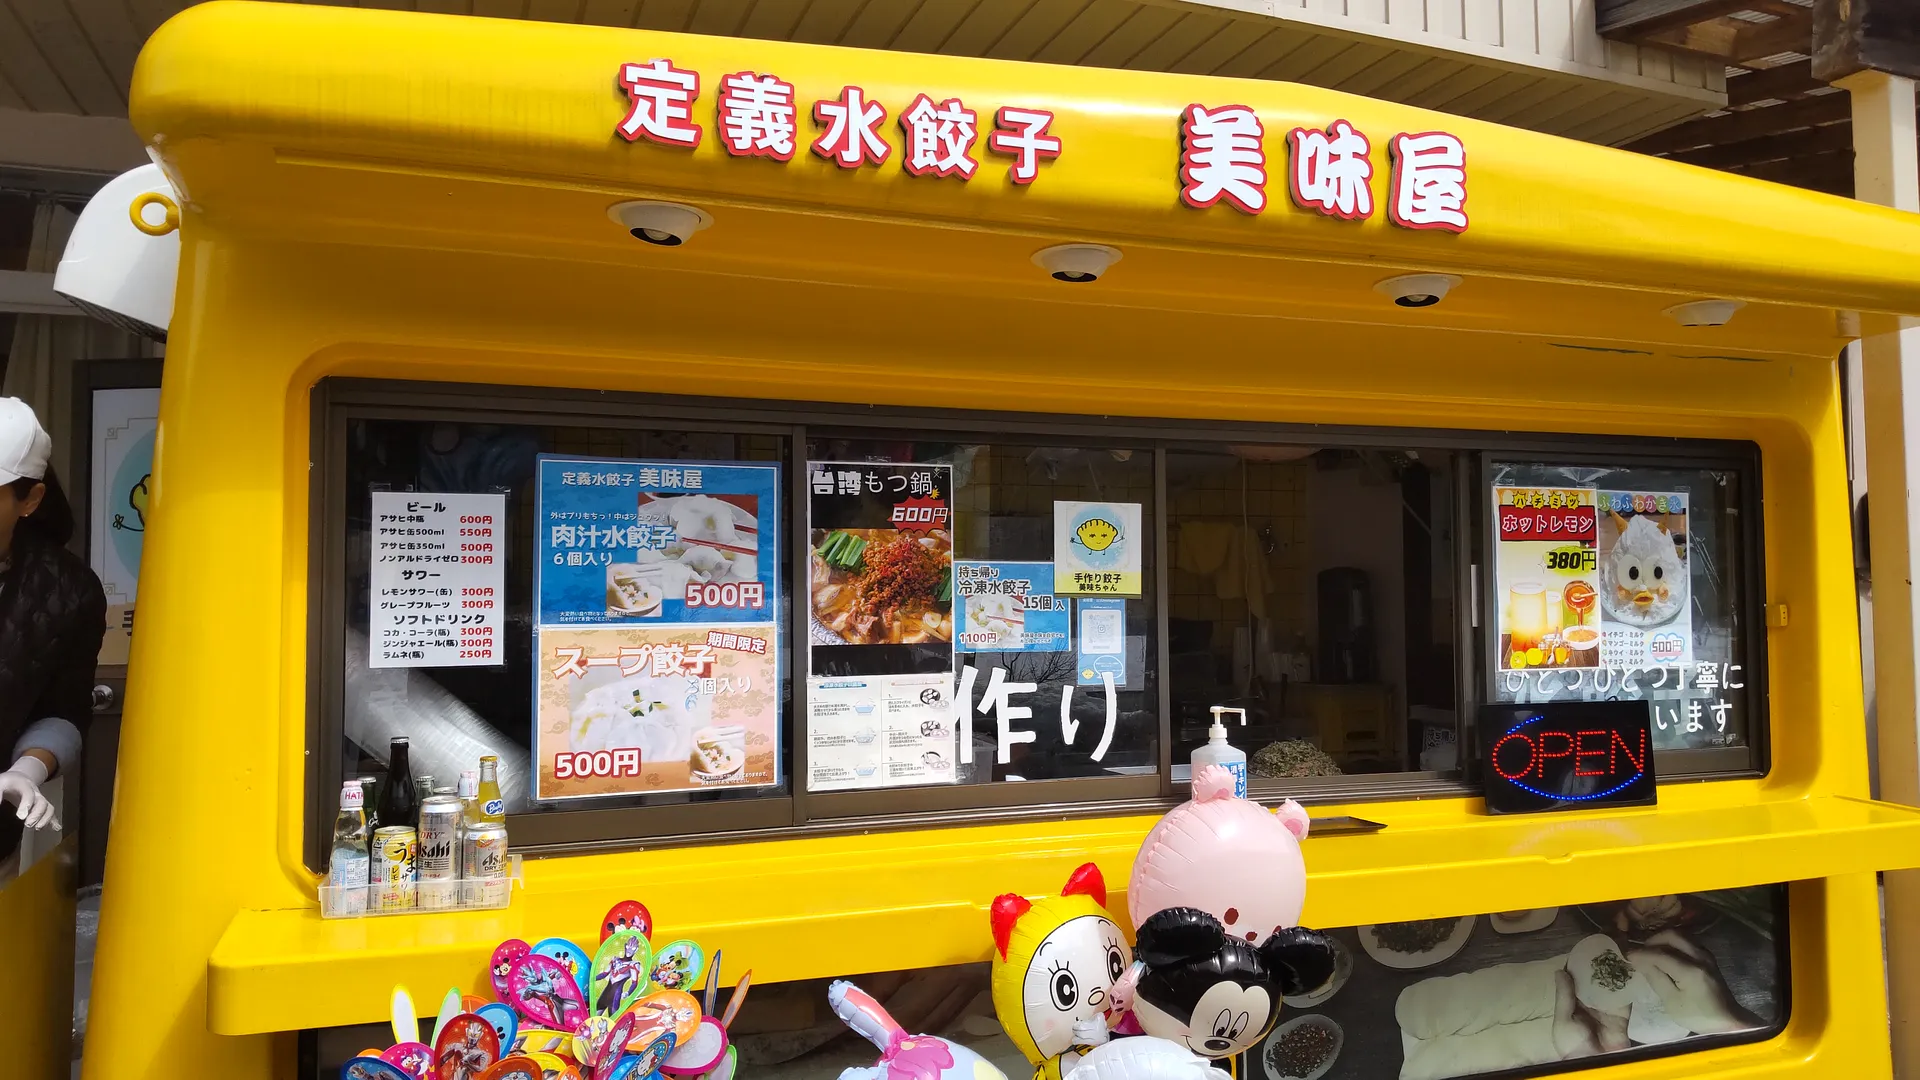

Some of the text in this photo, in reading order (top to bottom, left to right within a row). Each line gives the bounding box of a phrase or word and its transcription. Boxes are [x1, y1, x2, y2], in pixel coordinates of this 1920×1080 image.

[618, 59, 1469, 233] 定義水餃子 美味屋
[562, 467, 703, 489] 定義水餃子 美味屋
[812, 471, 933, 496] 台湾もつ鍋
[407, 502, 446, 513] ビール
[1514, 493, 1579, 508] ハチミツ
[1599, 495, 1680, 511] ふわふわかき氷
[380, 515, 492, 524] アサヒ中瓶 600円
[891, 506, 949, 524] 600円
[1502, 514, 1594, 534] ホットレモン
[380, 528, 492, 537] アサヒ缶500ml 550円
[551, 524, 677, 550] 肉汁水餃子
[380, 542, 493, 552] アサヒ缶350ml 500円
[379, 555, 493, 565] ノンアルドライゼロ 300円
[553, 552, 613, 567] 6個入り
[1547, 551, 1597, 571] 380円
[401, 570, 441, 581] サワー
[958, 566, 999, 578] 持ち帰り
[1074, 573, 1122, 583] 手作り餃子
[381, 587, 494, 597] レモンサワー(缶) 300円
[958, 580, 1031, 595] 冷凍水餃子
[1079, 583, 1117, 592] 美味ちゃん
[686, 583, 764, 608] 500円
[380, 600, 494, 610] グレープフルーツ 300円
[394, 614, 485, 625] ソフトドリンク
[460, 627, 493, 636] 300円
[959, 632, 997, 644] 1100円
[460, 638, 493, 648] 300円
[708, 632, 766, 654] 期間限定
[1652, 639, 1682, 653] 500円
[459, 649, 492, 659] 250円
[553, 643, 717, 679] スープ餃子
[1656, 698, 1732, 732] います
[1493, 728, 1646, 779] OPEN
[555, 748, 641, 779] 500円
